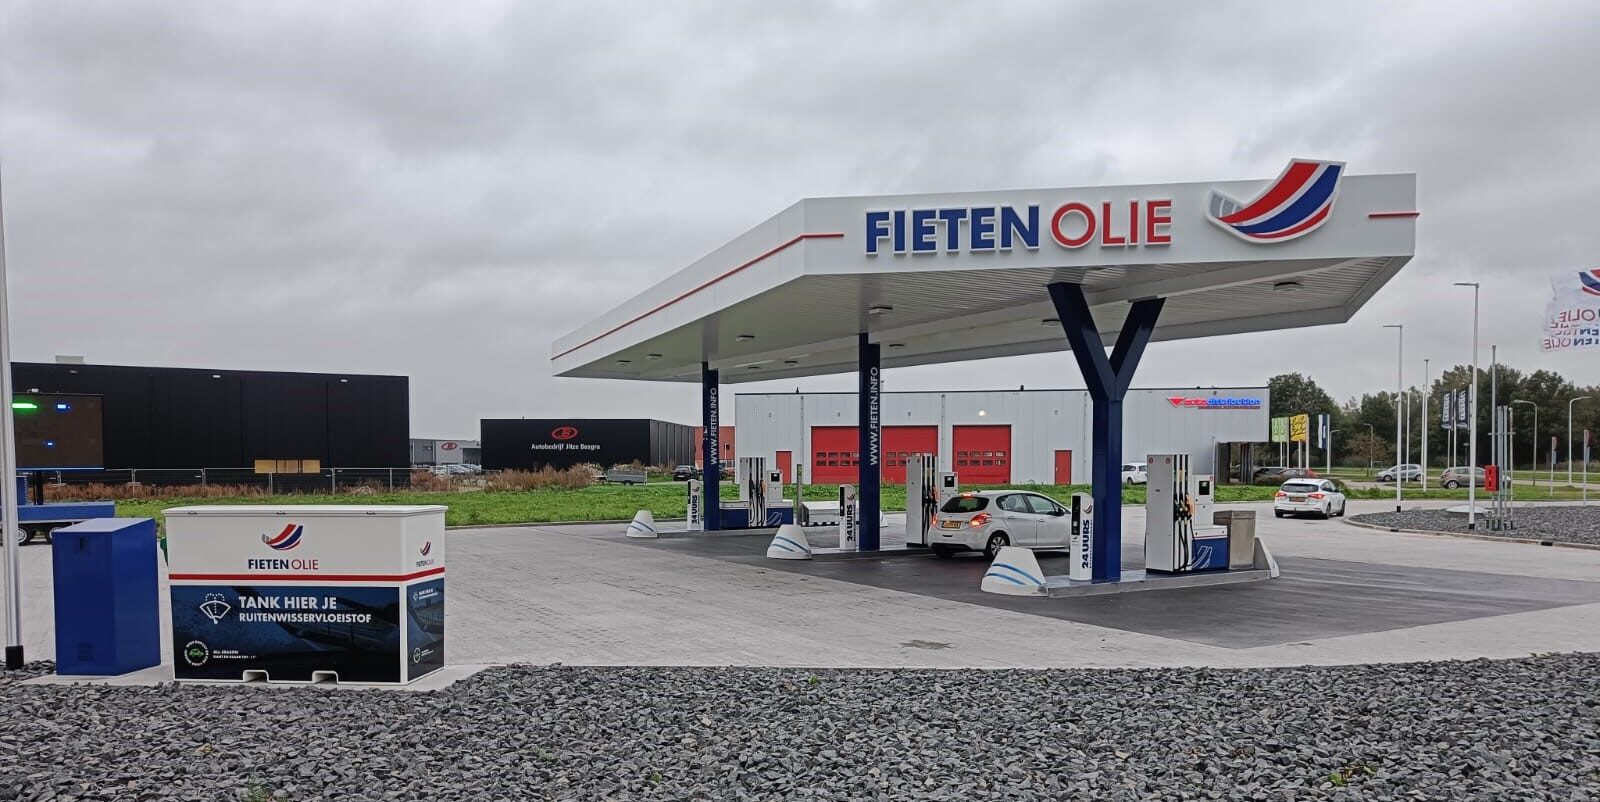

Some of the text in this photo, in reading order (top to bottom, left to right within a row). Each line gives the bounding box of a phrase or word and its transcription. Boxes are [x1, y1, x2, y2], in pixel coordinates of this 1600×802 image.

[865, 199, 1173, 255] FIETEN OLIE
[870, 367, 878, 466] WWW.FIETEN.INFO
[248, 559, 319, 570] FIETEN OLIE
[238, 596, 337, 609] TANK HIER JE
[239, 613, 372, 623] RUITENWISSERVLOEISTOF
